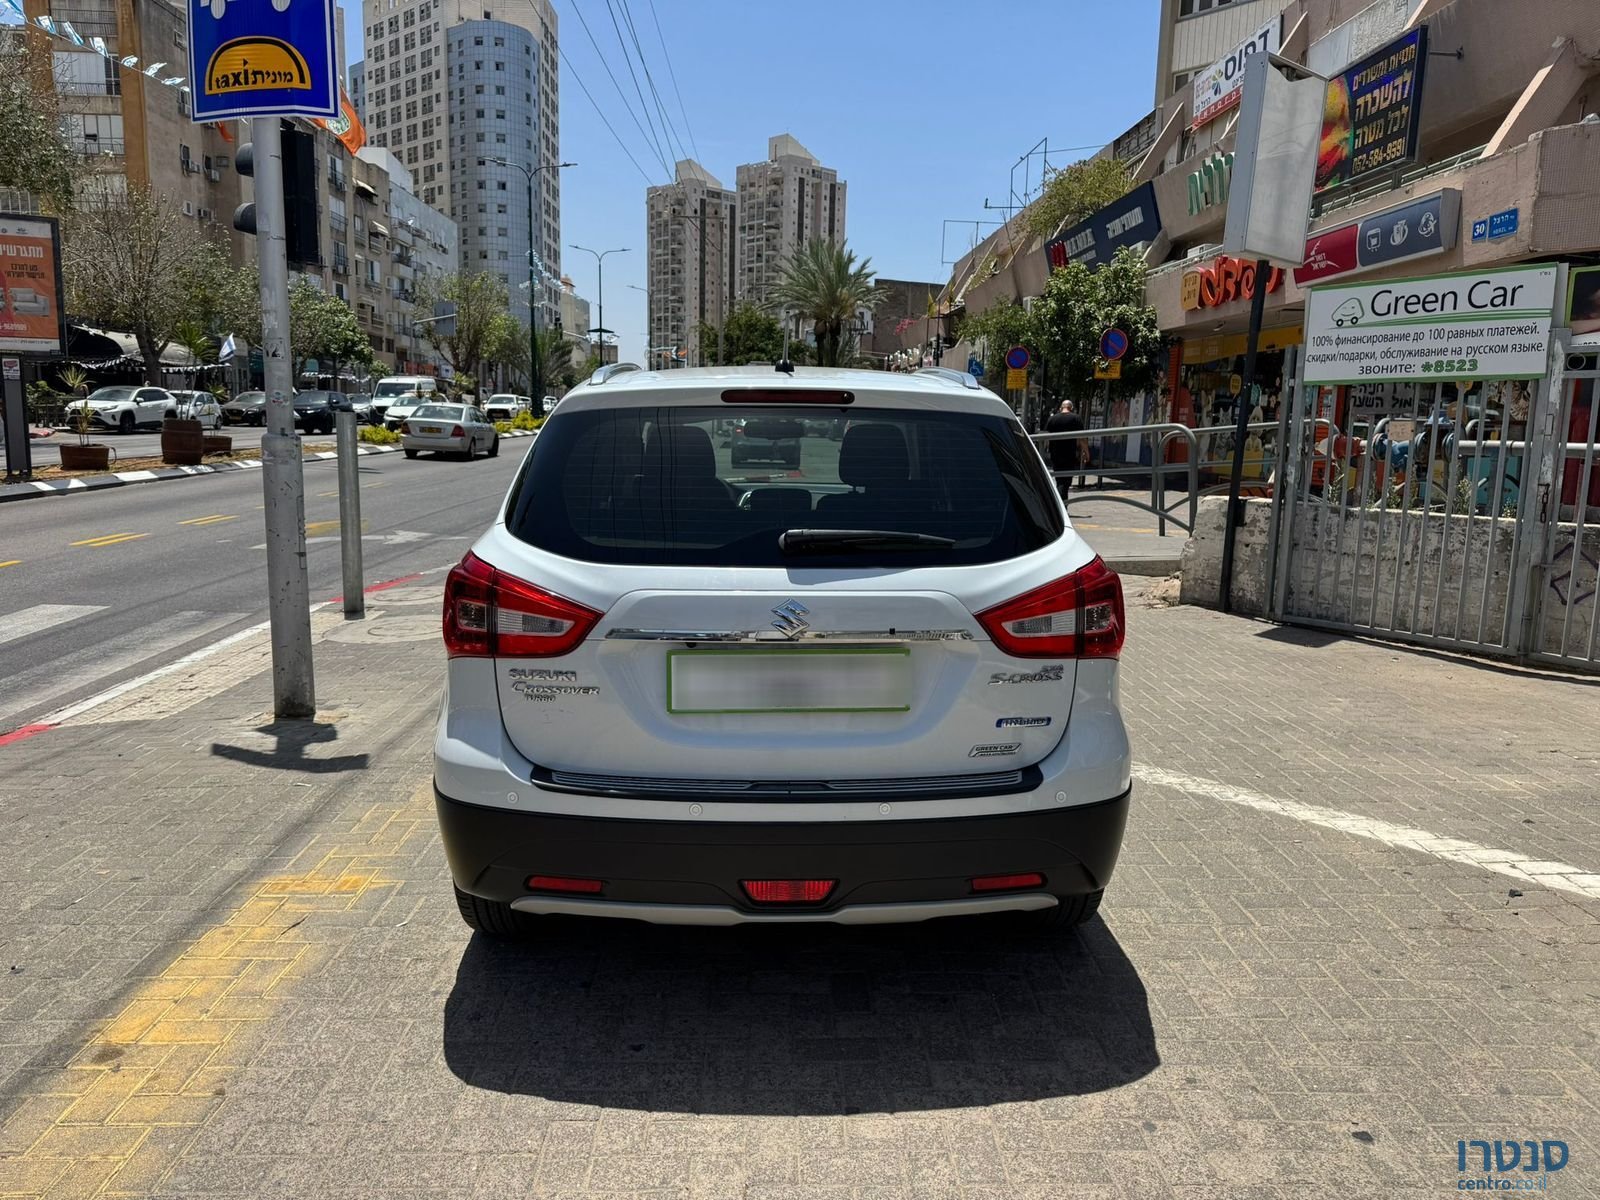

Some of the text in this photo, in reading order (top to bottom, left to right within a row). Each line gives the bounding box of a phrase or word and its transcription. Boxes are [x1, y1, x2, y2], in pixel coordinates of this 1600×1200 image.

[216, 59, 249, 89] taxi
[251, 69, 294, 85] מונית
[1355, 69, 1413, 122] להשכרה
[1354, 117, 1385, 150] מטרה
[1474, 223, 1485, 236] 30
[0, 244, 44, 258] מתגרשי
[1371, 280, 1524, 316] Green Car
[1312, 322, 1540, 348] 100% финансирование до 100 равных платежей.
[1307, 342, 1545, 364] скидки/подарки, обслуживание на русском языке.
[1358, 363, 1416, 375] звоните:
[1352, 395, 1413, 409] מול השער
[508, 668, 577, 681] SUZUKI
[524, 693, 556, 703] TURBO
